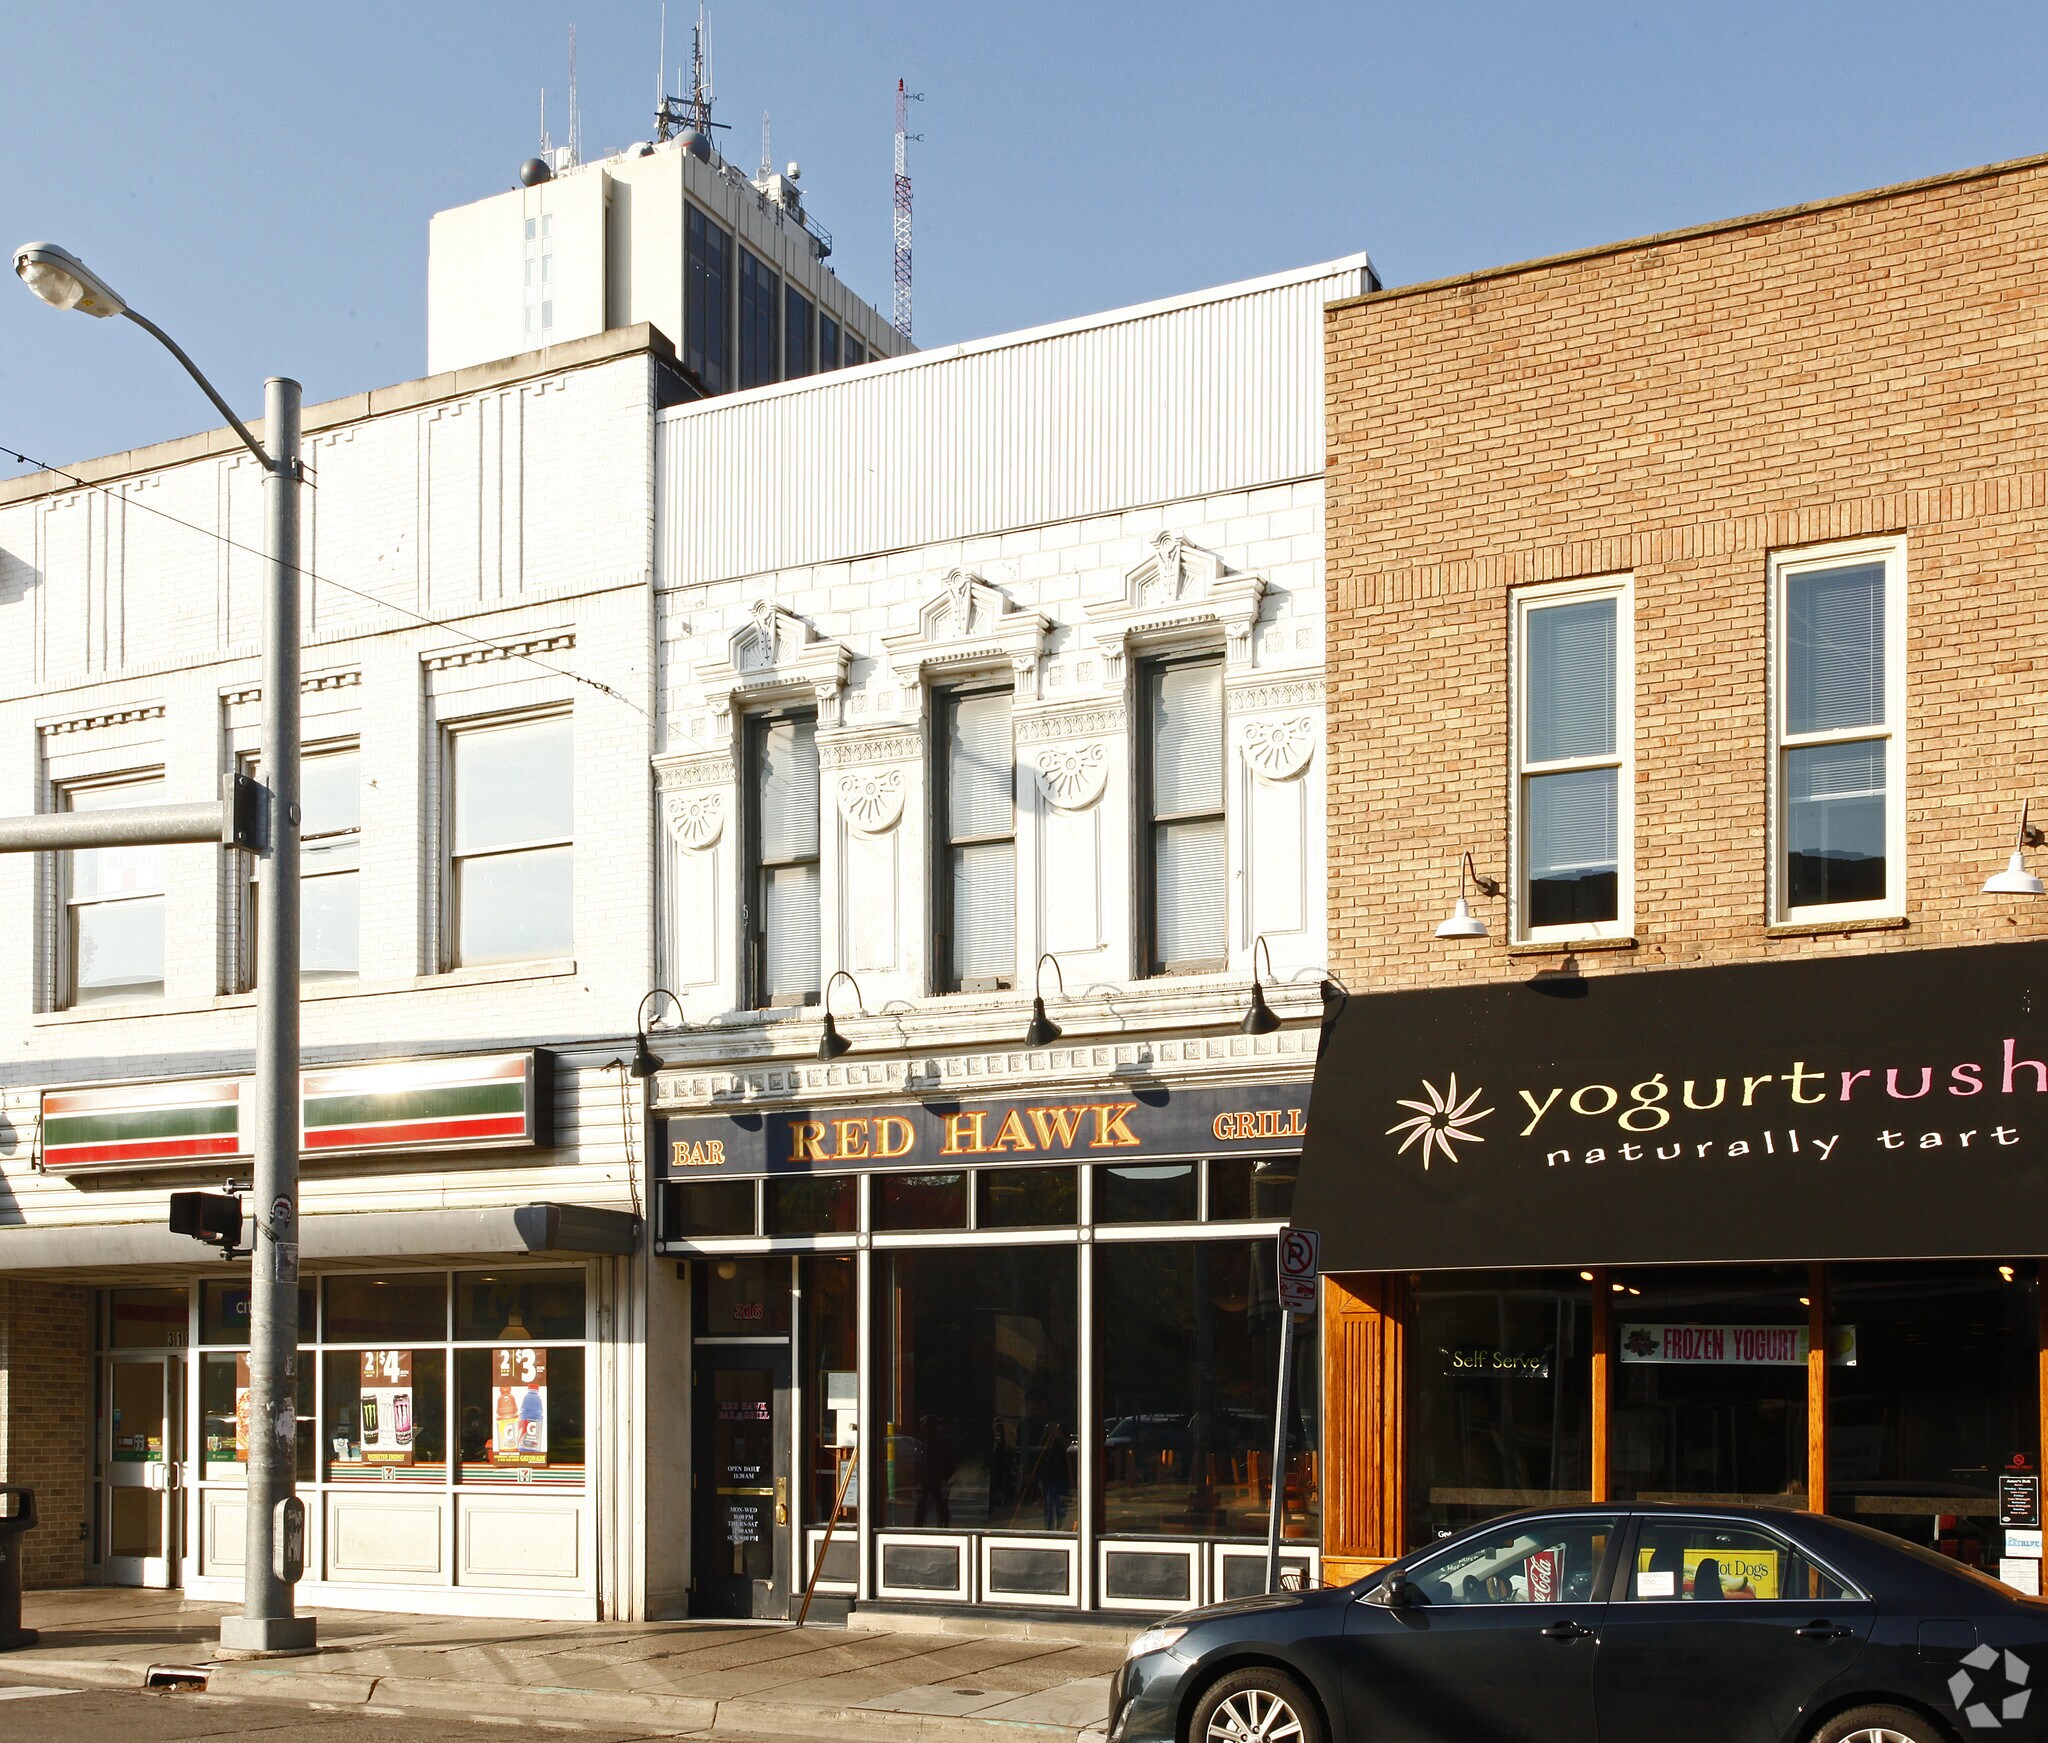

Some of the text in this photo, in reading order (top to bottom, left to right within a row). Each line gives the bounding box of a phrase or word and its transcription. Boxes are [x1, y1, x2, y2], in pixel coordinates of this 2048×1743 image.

[787, 1102, 1141, 1163] RED HAWK
[1212, 1108, 1307, 1140] GRILL
[672, 1140, 725, 1166] BAR
[1546, 1125, 2020, 1167] naturally tart
[735, 1303, 763, 1319] 316
[1663, 1328, 1798, 1361] FROZEN YOGURT
[365, 1351, 375, 1370] 2
[500, 1349, 510, 1369] 2
[1453, 1350, 1540, 1369] Self Serve
[1717, 1560, 1768, 1581] ot Dogs
